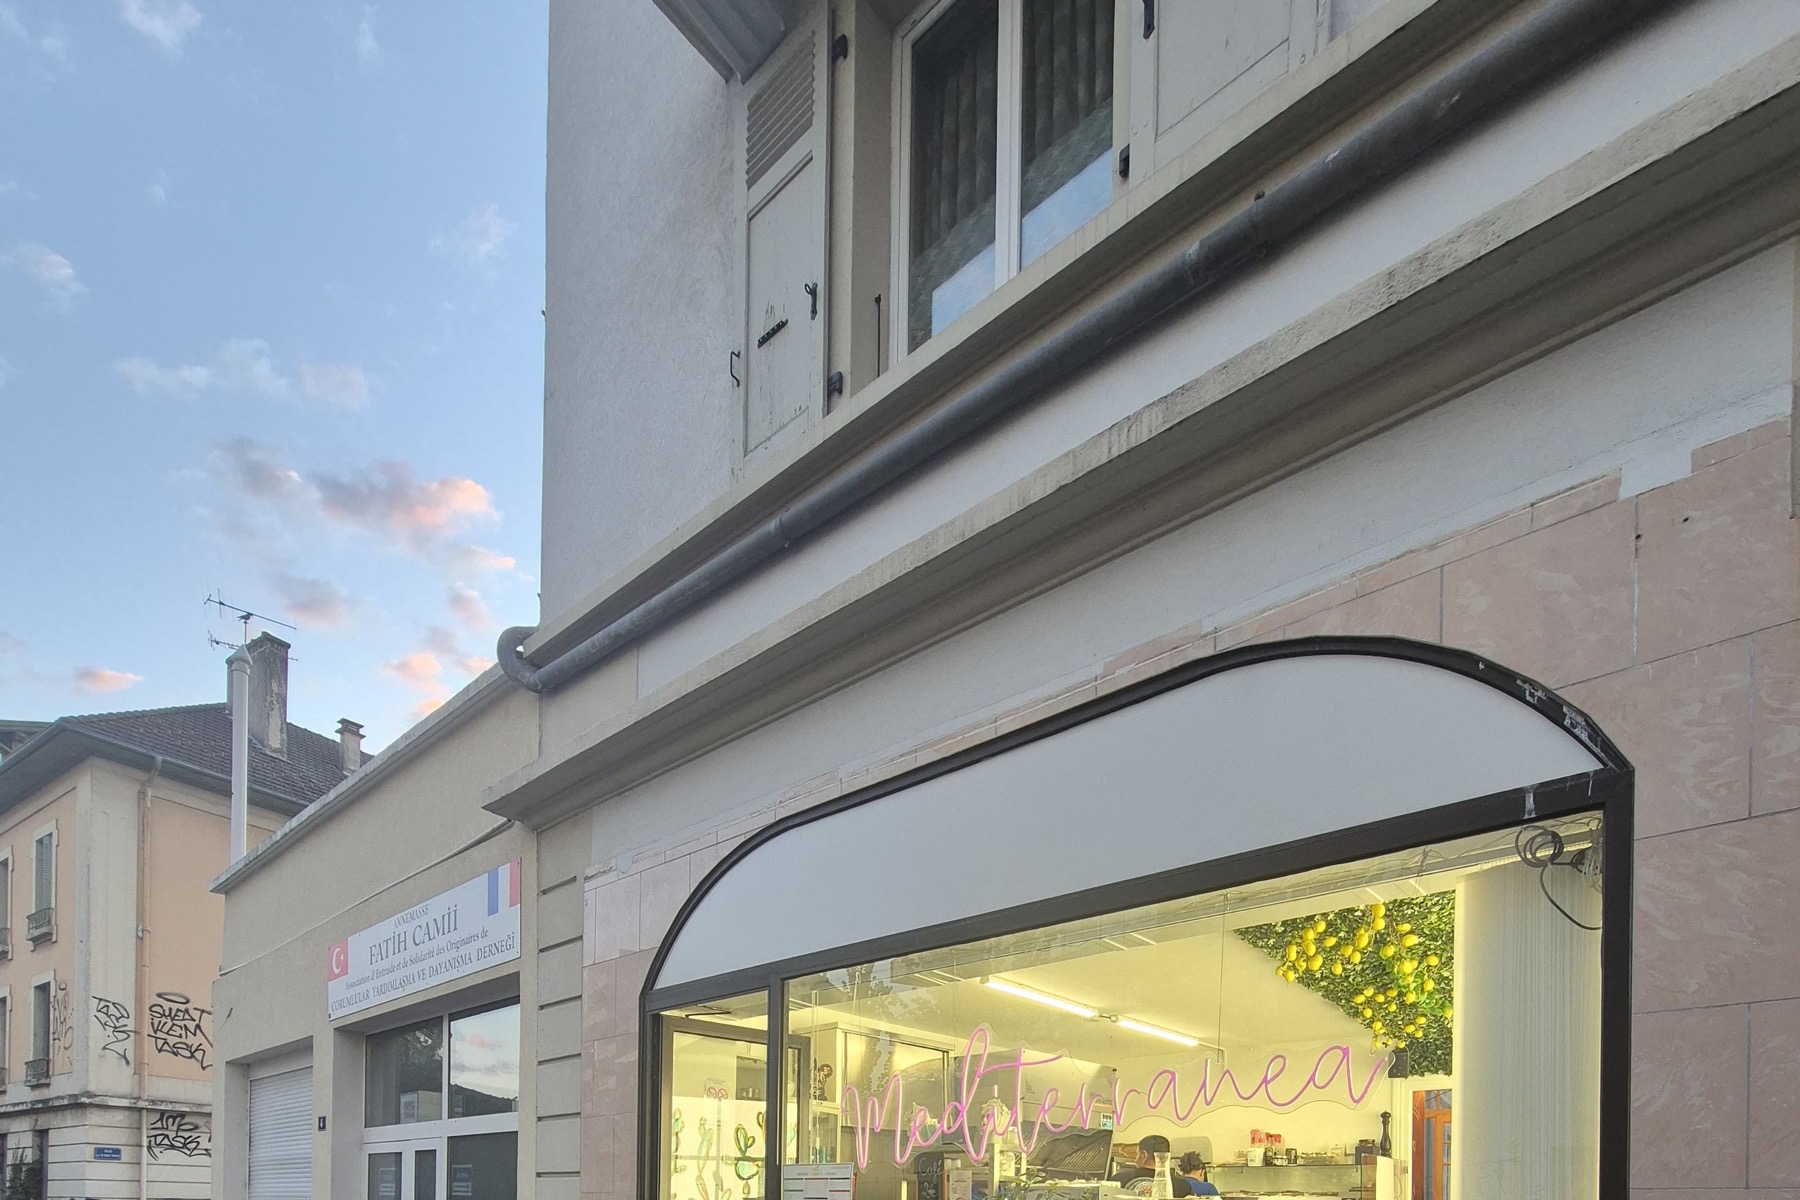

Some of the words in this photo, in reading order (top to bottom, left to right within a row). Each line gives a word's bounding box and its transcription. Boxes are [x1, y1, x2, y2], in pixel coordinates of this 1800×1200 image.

[369, 930, 407, 966] FATİH
[413, 903, 458, 947] CAMİİ
[480, 925, 489, 939] de
[841, 1027, 1386, 1170] Mediterranea
[918, 1157, 943, 1184] Café
